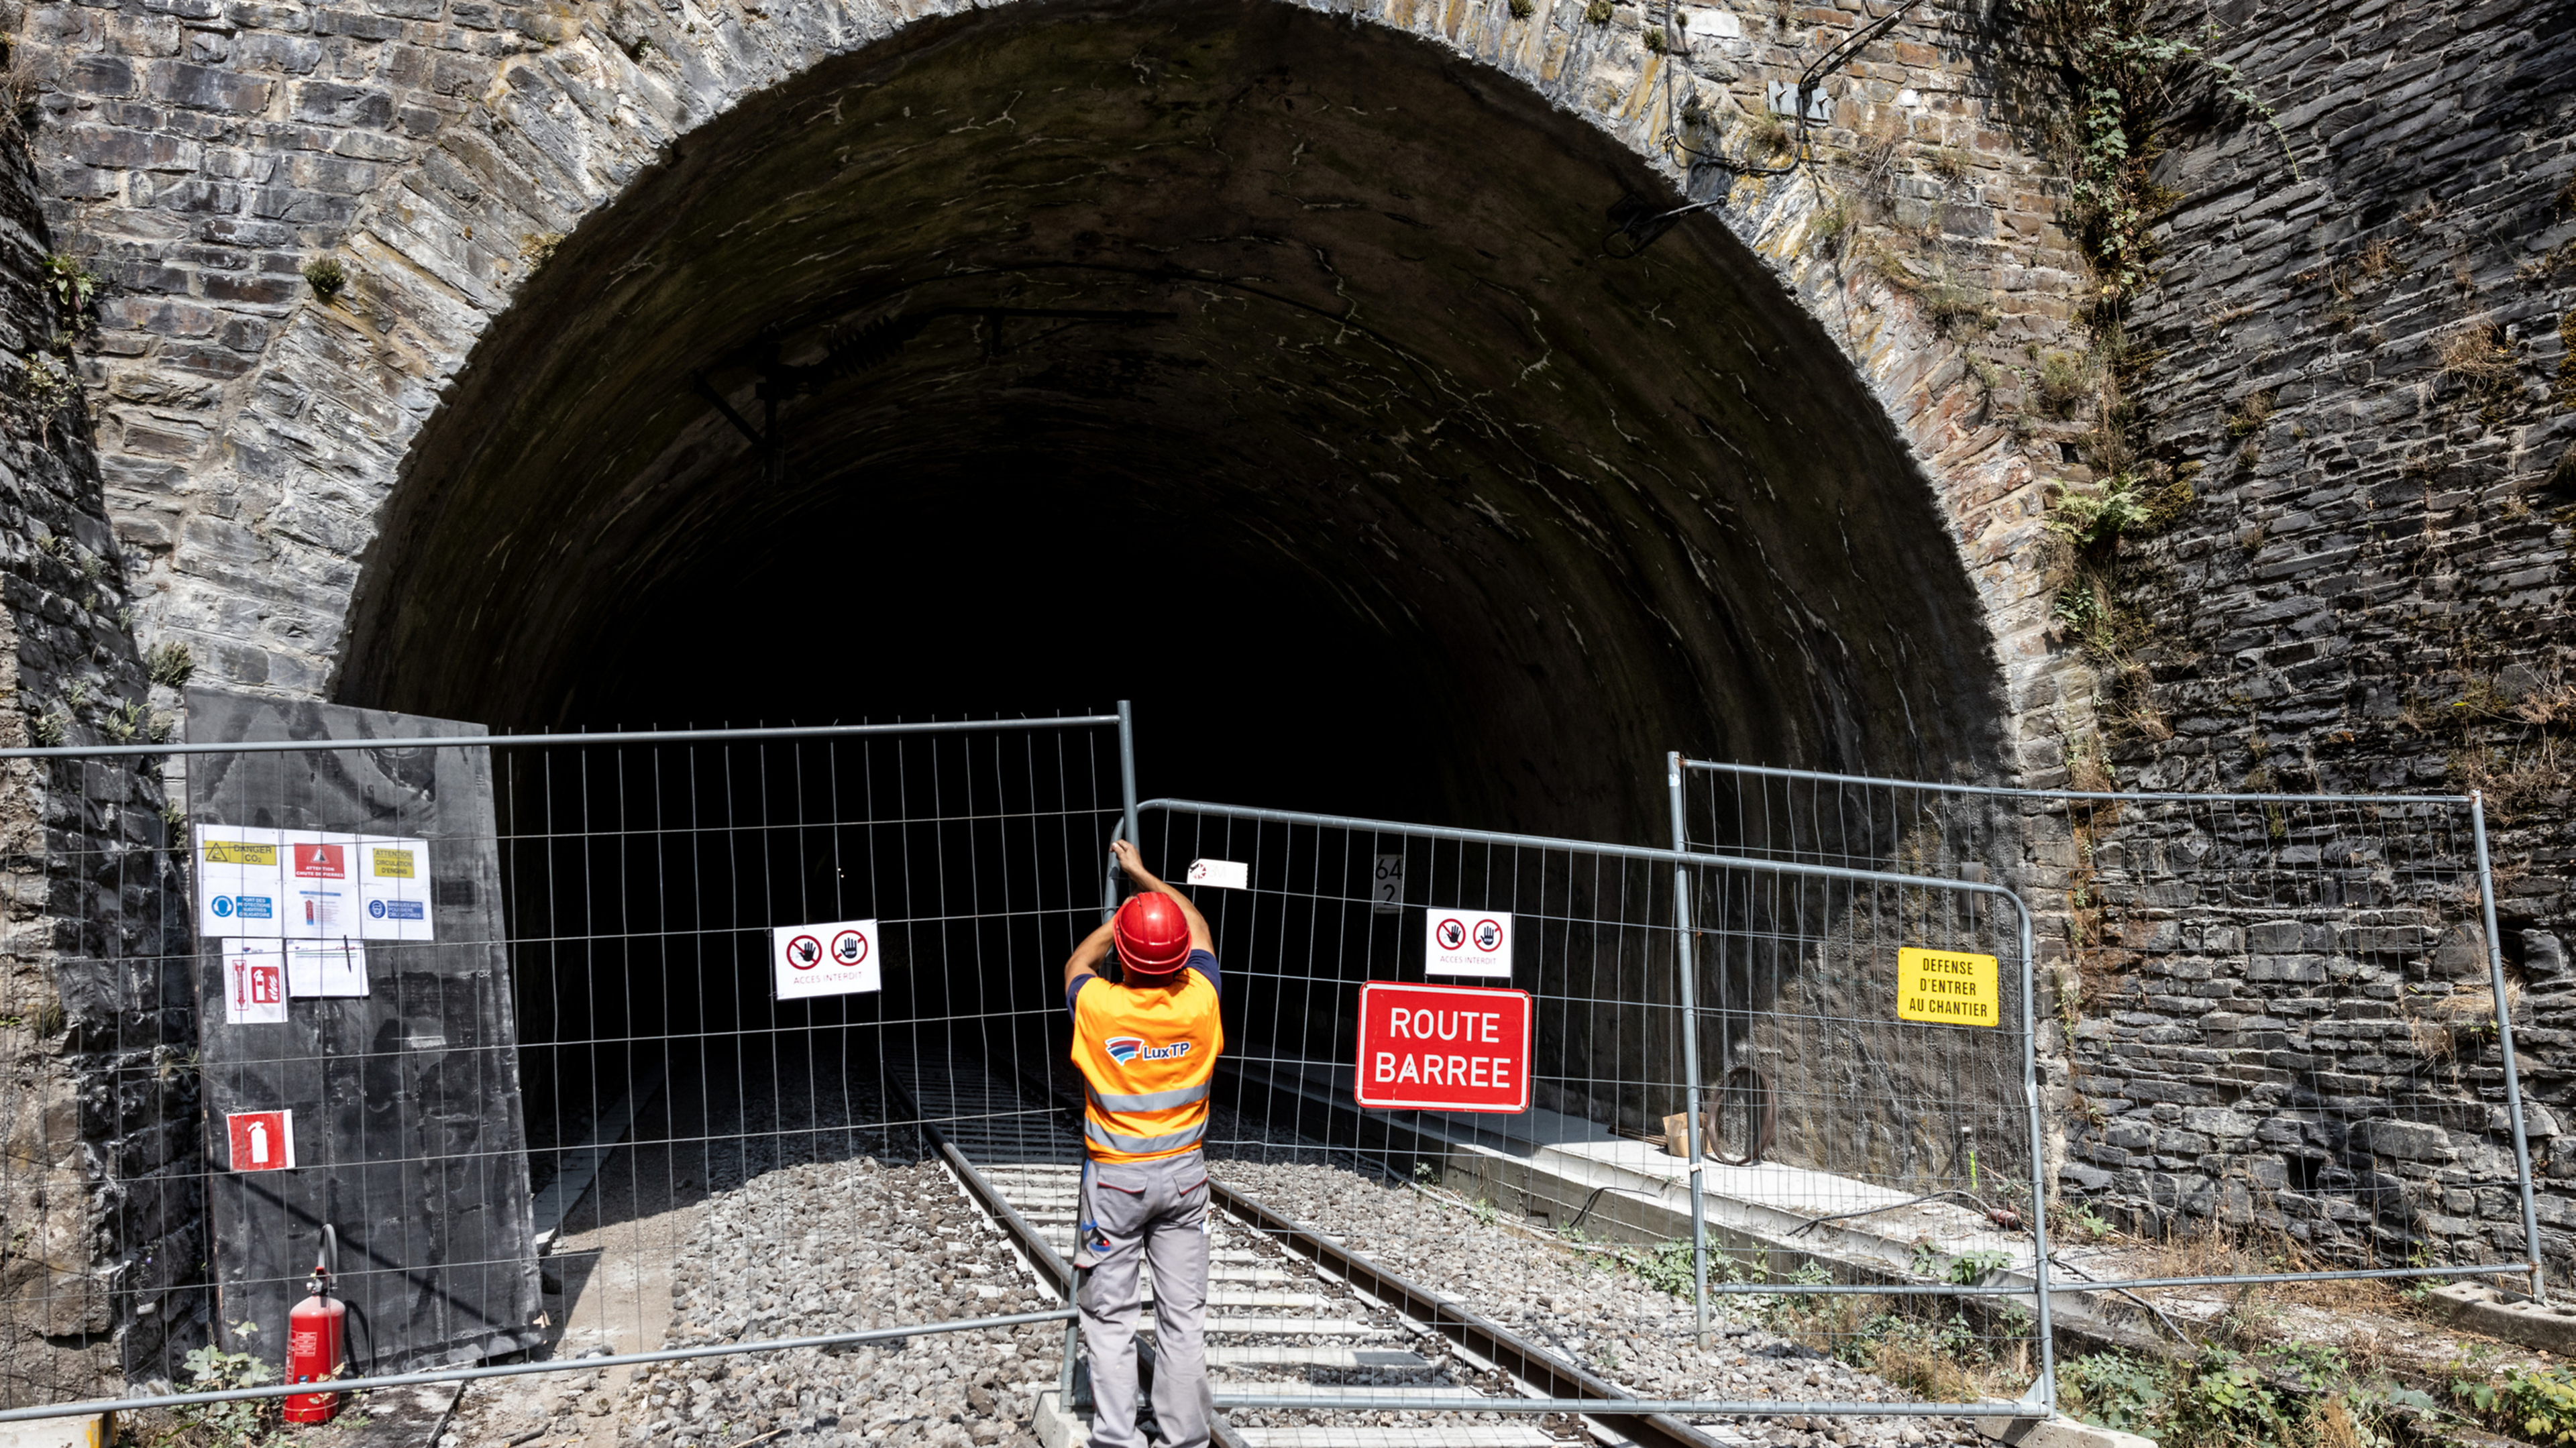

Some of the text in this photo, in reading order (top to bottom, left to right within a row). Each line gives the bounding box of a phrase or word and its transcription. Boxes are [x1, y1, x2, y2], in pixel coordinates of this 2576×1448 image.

[233, 844, 272, 854] DANGER
[1375, 859, 1403, 880] 64
[1383, 884, 1395, 905] 2
[1923, 958, 1974, 975] DEFENSE
[794, 972, 862, 984] ACCES INTERDIT
[1920, 978, 1976, 996] D'ENTRER
[1909, 998, 1987, 1017] AU CHANTIER
[1390, 1007, 1500, 1043] ROUTE
[1375, 1052, 1511, 1088] BARREE
